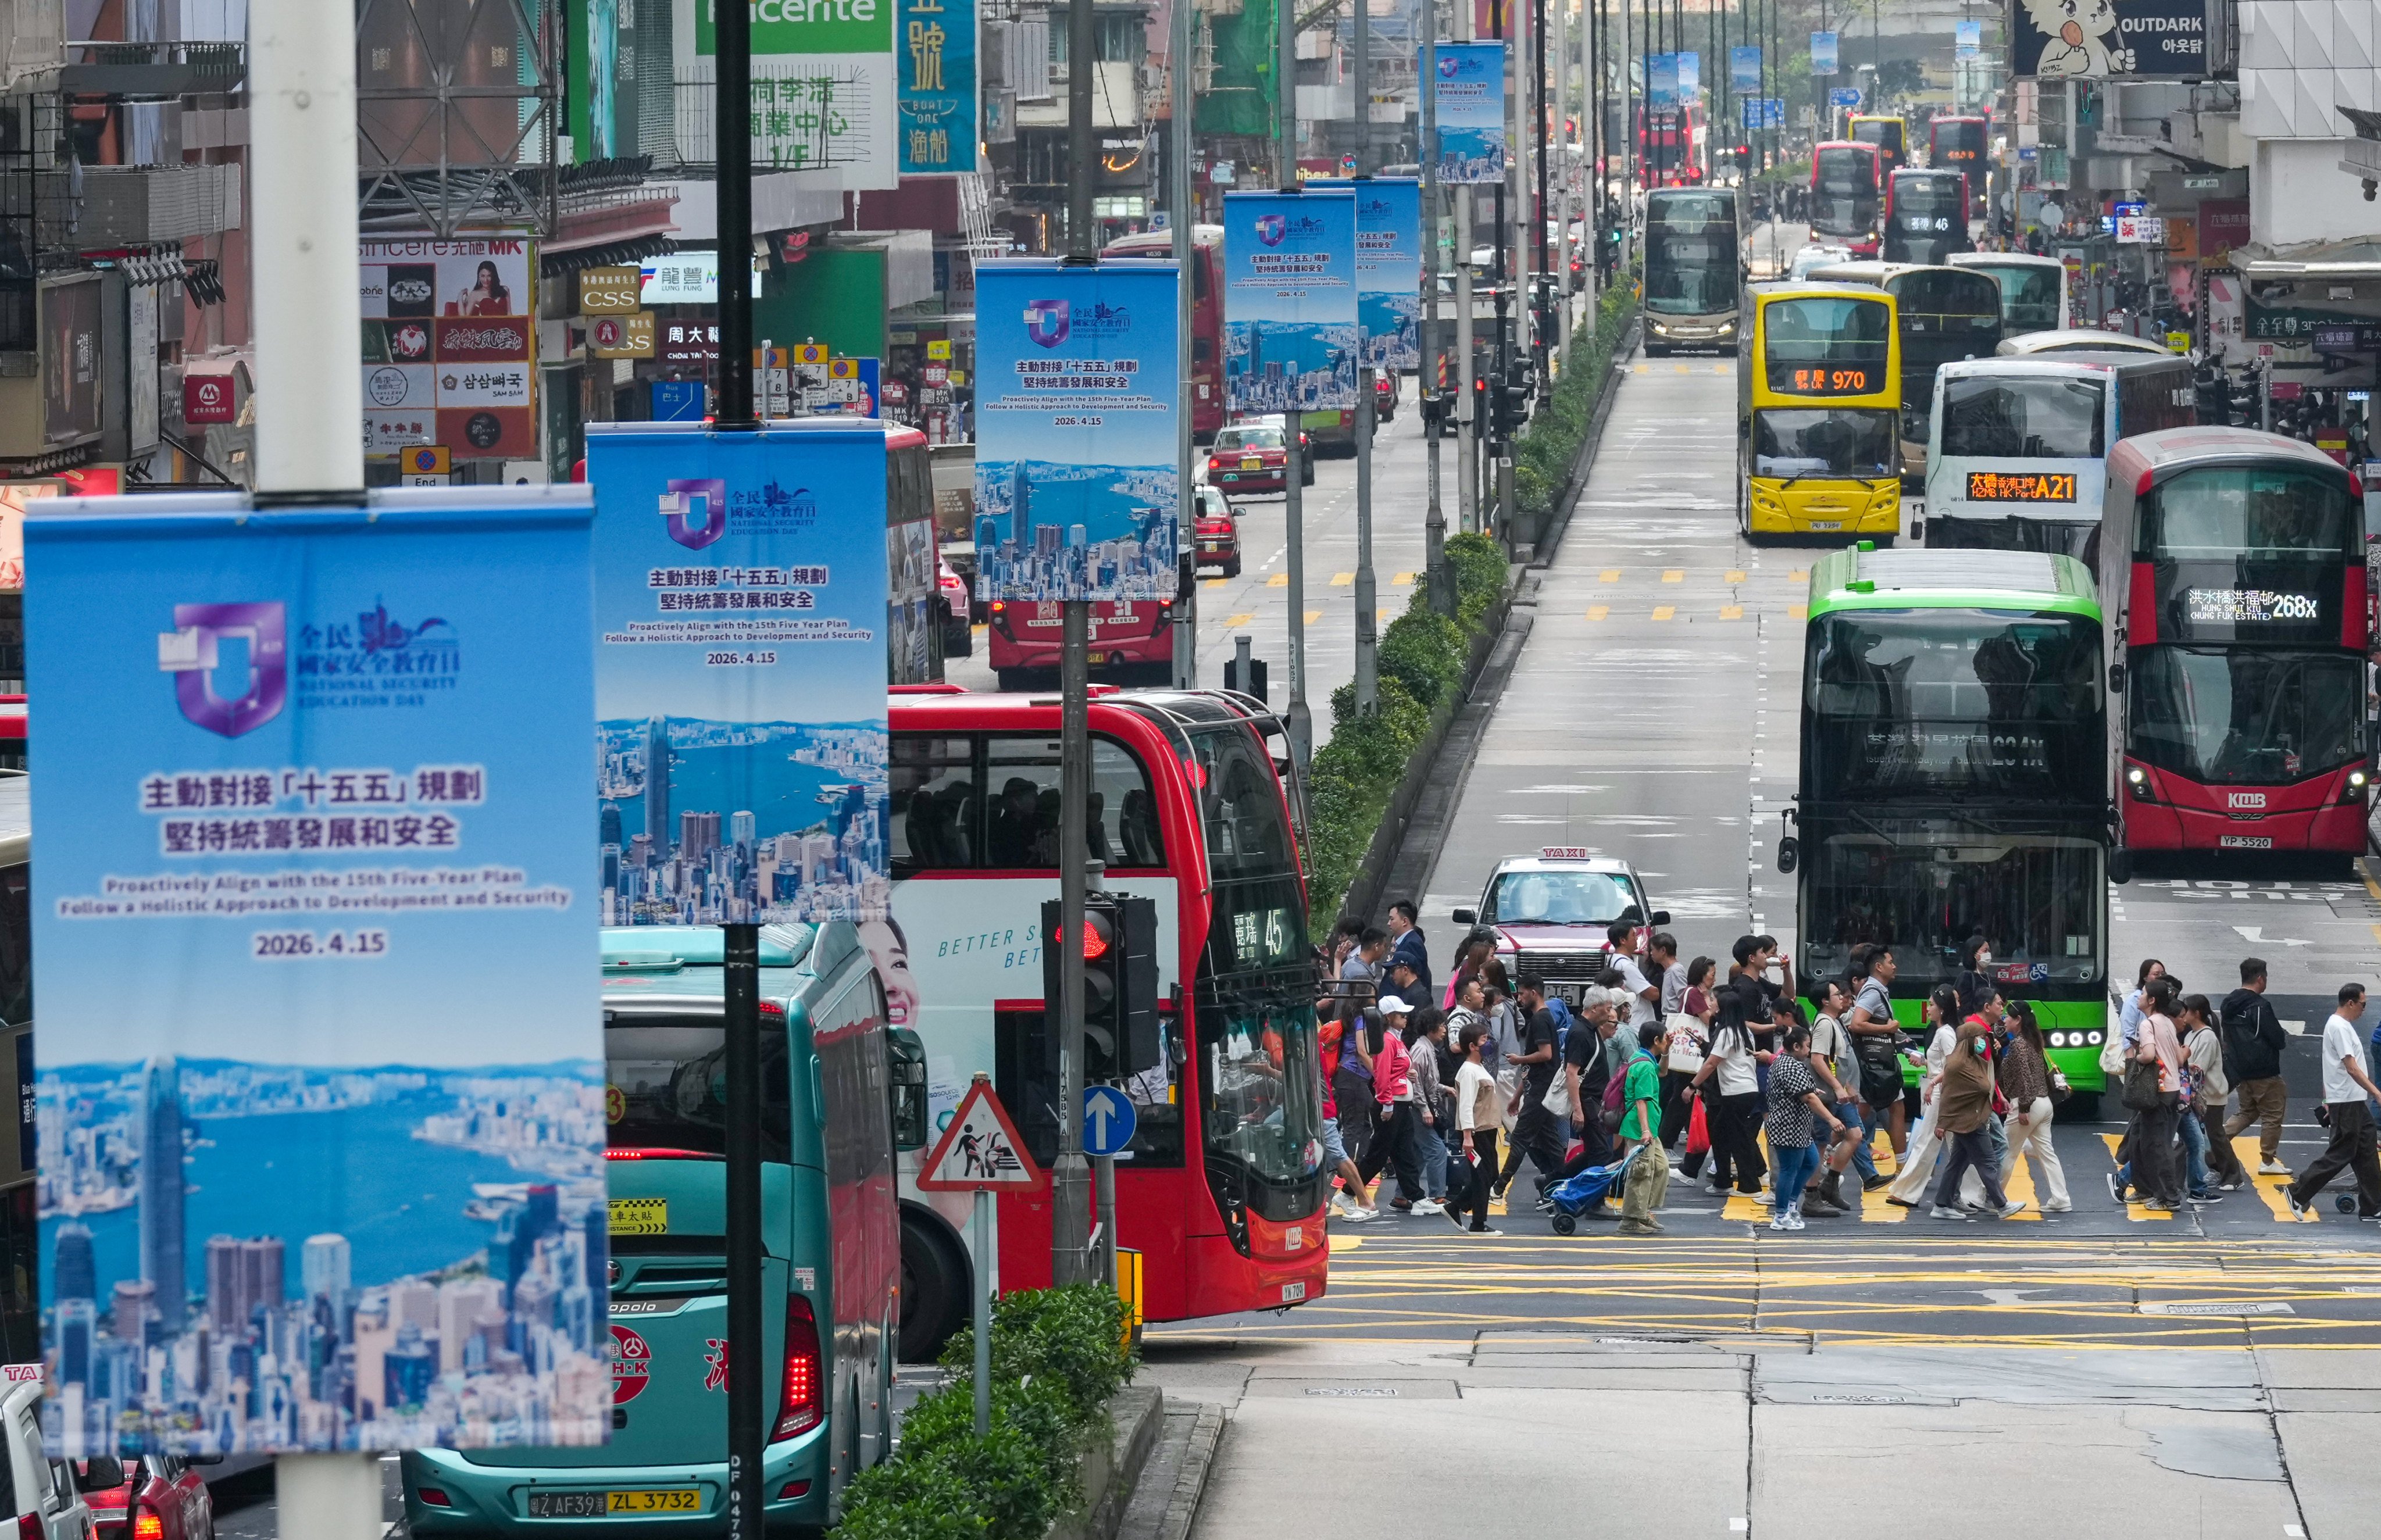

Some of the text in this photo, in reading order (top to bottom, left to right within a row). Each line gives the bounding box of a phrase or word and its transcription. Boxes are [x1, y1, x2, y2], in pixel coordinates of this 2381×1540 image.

[708, 0, 876, 23] icerite
[2121, 17, 2203, 33] OUTDARK
[2162, 39, 2203, 54] 아웃닭
[908, 129, 948, 164] 漁船
[662, 267, 702, 285] 龍豐
[584, 291, 635, 306] CSS
[1074, 308, 1092, 318] 全民
[1072, 319, 1130, 328] 國家安全教育日
[2256, 317, 2297, 335] 金至尊
[603, 335, 651, 351] SS
[2315, 332, 2354, 342] 六福珠寶
[815, 366, 821, 374] 7
[1016, 360, 1137, 373] 主動對接「十五五」規劃
[463, 372, 523, 390] 삼삼뼈국
[774, 370, 781, 378] 7
[1832, 370, 1865, 390] 970
[775, 384, 781, 392] 8
[845, 380, 851, 388] 7
[1023, 376, 1128, 389] 堅持統籌發展和安全
[1811, 381, 1823, 390] Uk
[662, 393, 681, 402] 巴士
[846, 393, 853, 401] 8
[1055, 417, 1101, 426] 2026.4.15
[415, 478, 436, 487] End
[2036, 475, 2073, 499] A21
[731, 491, 761, 505] 全民
[1972, 488, 2036, 498] HZMB HK Port
[730, 505, 816, 519] 國家安全教育日
[649, 567, 827, 587] 主動對接「十五五」規劃
[660, 591, 814, 610] 堅持統籌發展和安全
[2189, 589, 2274, 605] 洪水橋洪福邨
[2190, 612, 2272, 621] (HUNG FUK ESTATE)
[630, 622, 684, 632] Proactively
[687, 622, 711, 631] Align
[713, 621, 734, 630] with
[737, 621, 753, 629] the
[755, 621, 776, 629] 15th
[827, 620, 847, 628] Plan
[605, 634, 637, 642] Follow
[686, 633, 730, 643] Approach
[747, 633, 809, 641] Development
[811, 631, 829, 639] and
[831, 630, 872, 640] Security
[707, 652, 775, 665] 2026.4.15
[144, 769, 482, 810] 主動對接「十五五」規劃
[2228, 793, 2266, 809] KMB
[165, 815, 458, 853] 堅持統籌發展和安全
[2223, 837, 2269, 848] YP 5520
[1543, 847, 1586, 858] TAXI
[106, 869, 523, 895] Proactively Align with the 15th Plan
[60, 890, 570, 914] Follow Holistic Approach to Development and Security
[1265, 909, 1283, 956] 45
[255, 931, 385, 956] 2026.4.15
[938, 924, 1043, 957] BETTER S
[1552, 985, 1569, 996] TF
[1061, 1071, 1065, 1079] K
[4, 1366, 44, 1381] TA
[613, 1492, 695, 1510] ZL 3732
